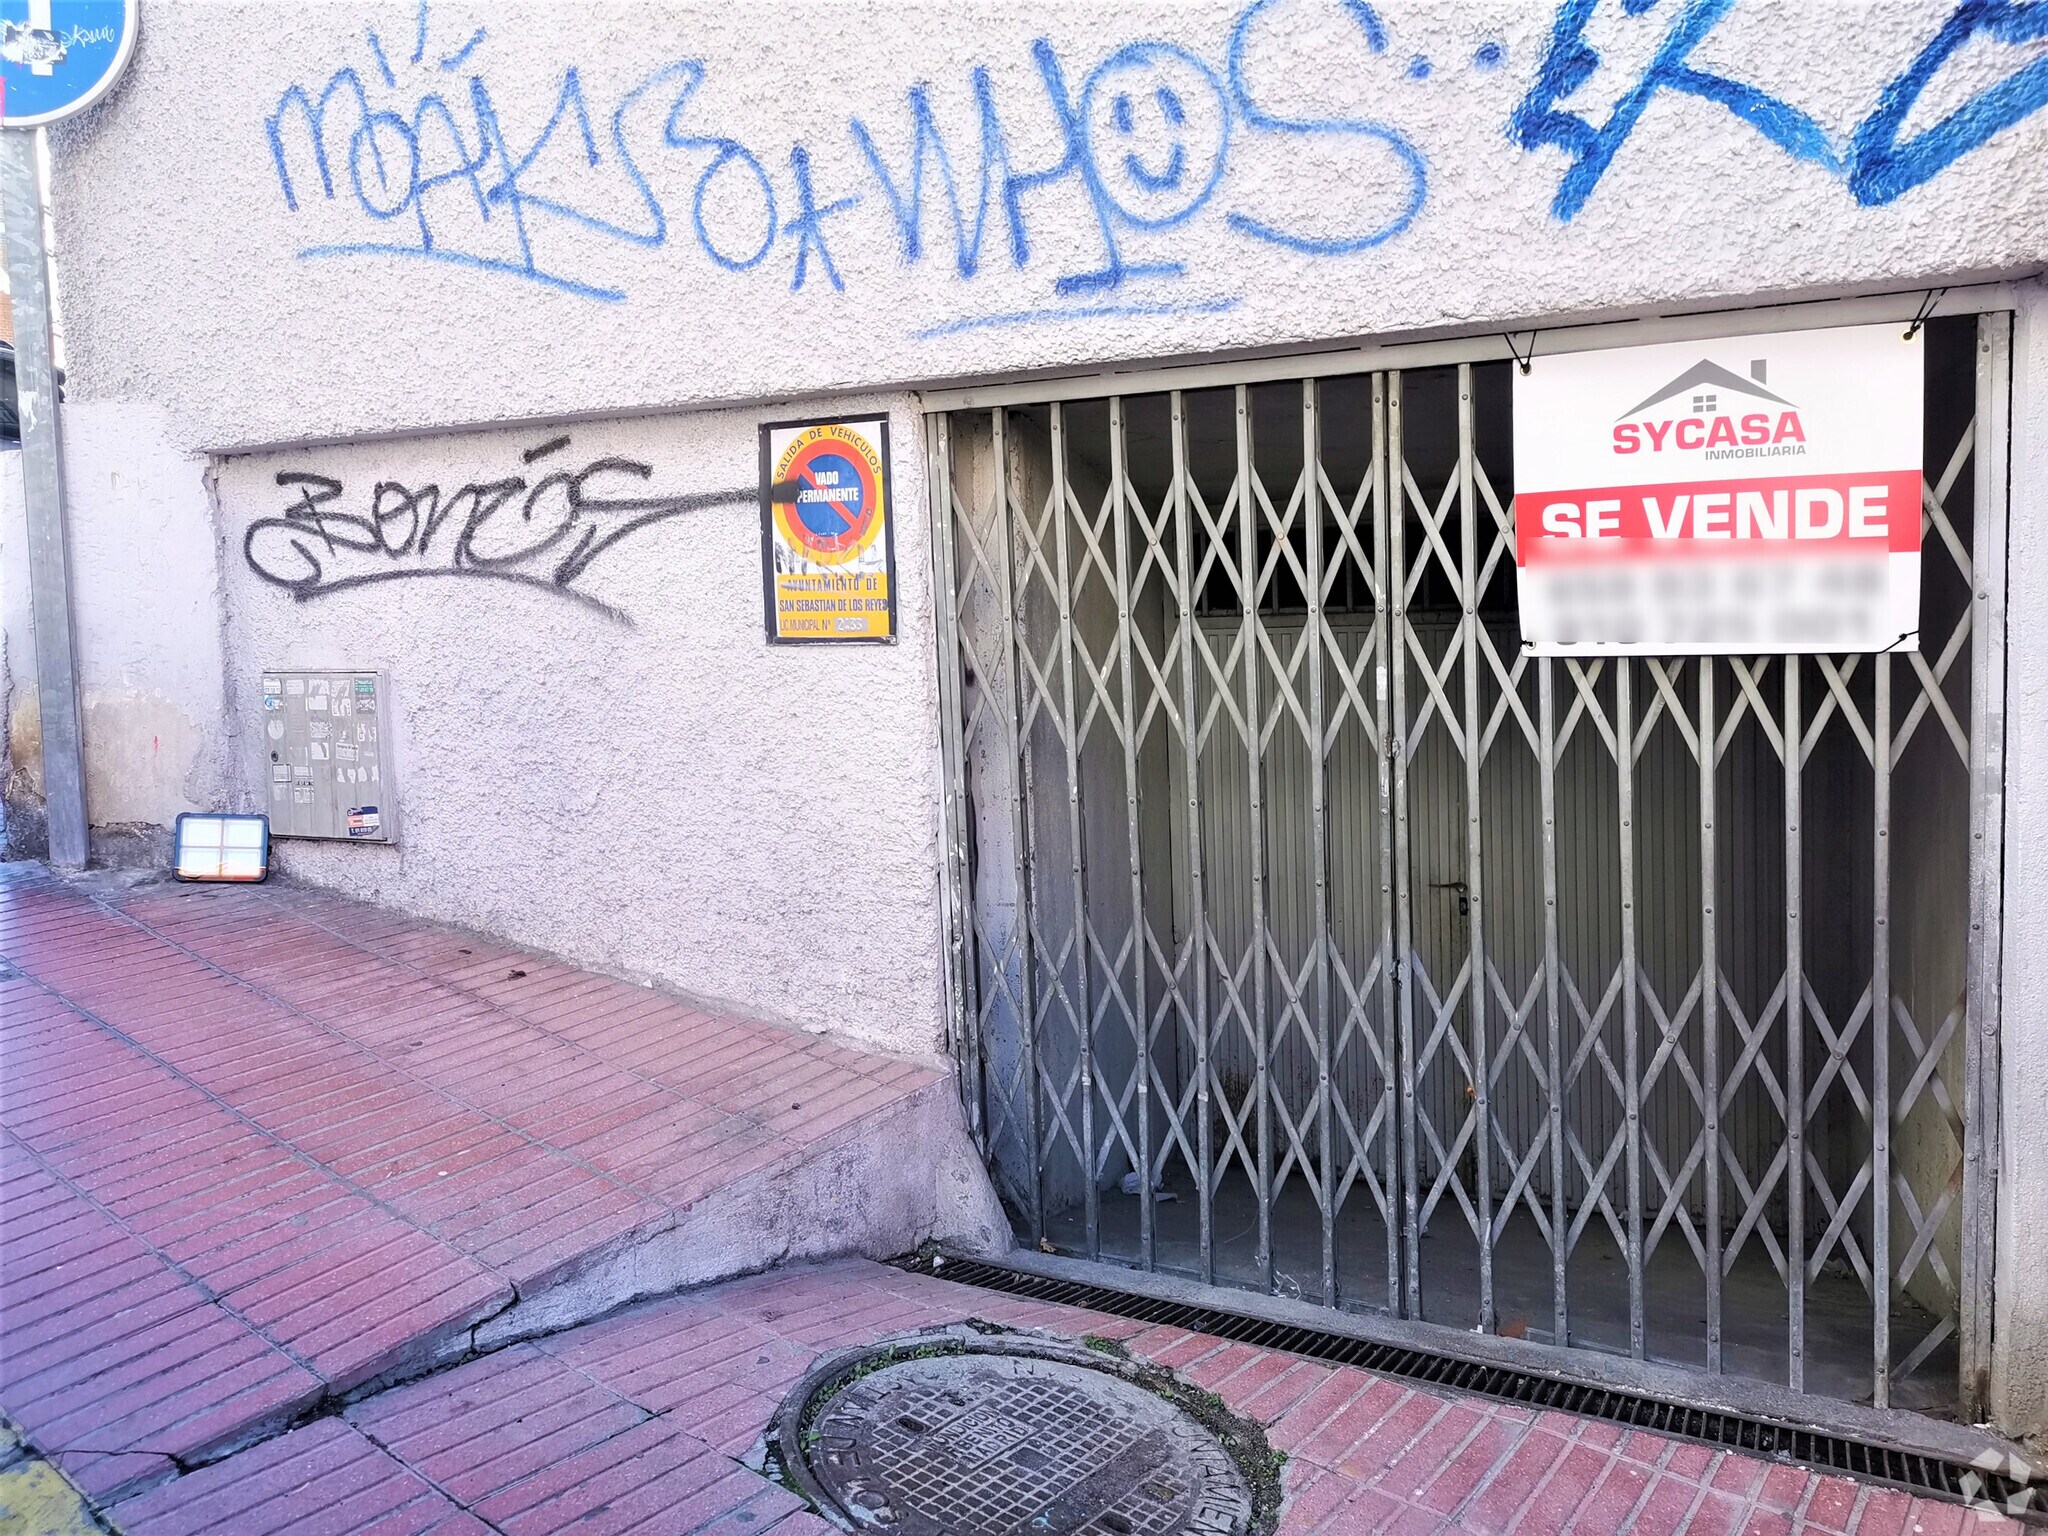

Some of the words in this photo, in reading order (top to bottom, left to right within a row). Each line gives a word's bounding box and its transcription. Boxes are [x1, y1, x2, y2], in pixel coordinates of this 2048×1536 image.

[1613, 411, 1806, 454] SYCASA
[777, 439, 805, 479] SALIDA
[809, 427, 823, 440] DE
[830, 426, 882, 474] VEHICULOS
[1704, 445, 1806, 461] INMOBILIARIA
[814, 471, 840, 486] VADO
[796, 486, 860, 504] PERMANENTE
[1541, 499, 1622, 539] SE
[1642, 484, 1889, 540] VENDE
[786, 578, 860, 592] AYUNTAMIENTO
[866, 577, 878, 590] DE
[779, 599, 795, 612] SAN
[796, 599, 836, 612] SEBASTIAN
[838, 599, 847, 612] DE
[849, 598, 863, 612] LOS
[865, 597, 889, 612] REYES
[958, 1425, 1030, 1465] MADRID
